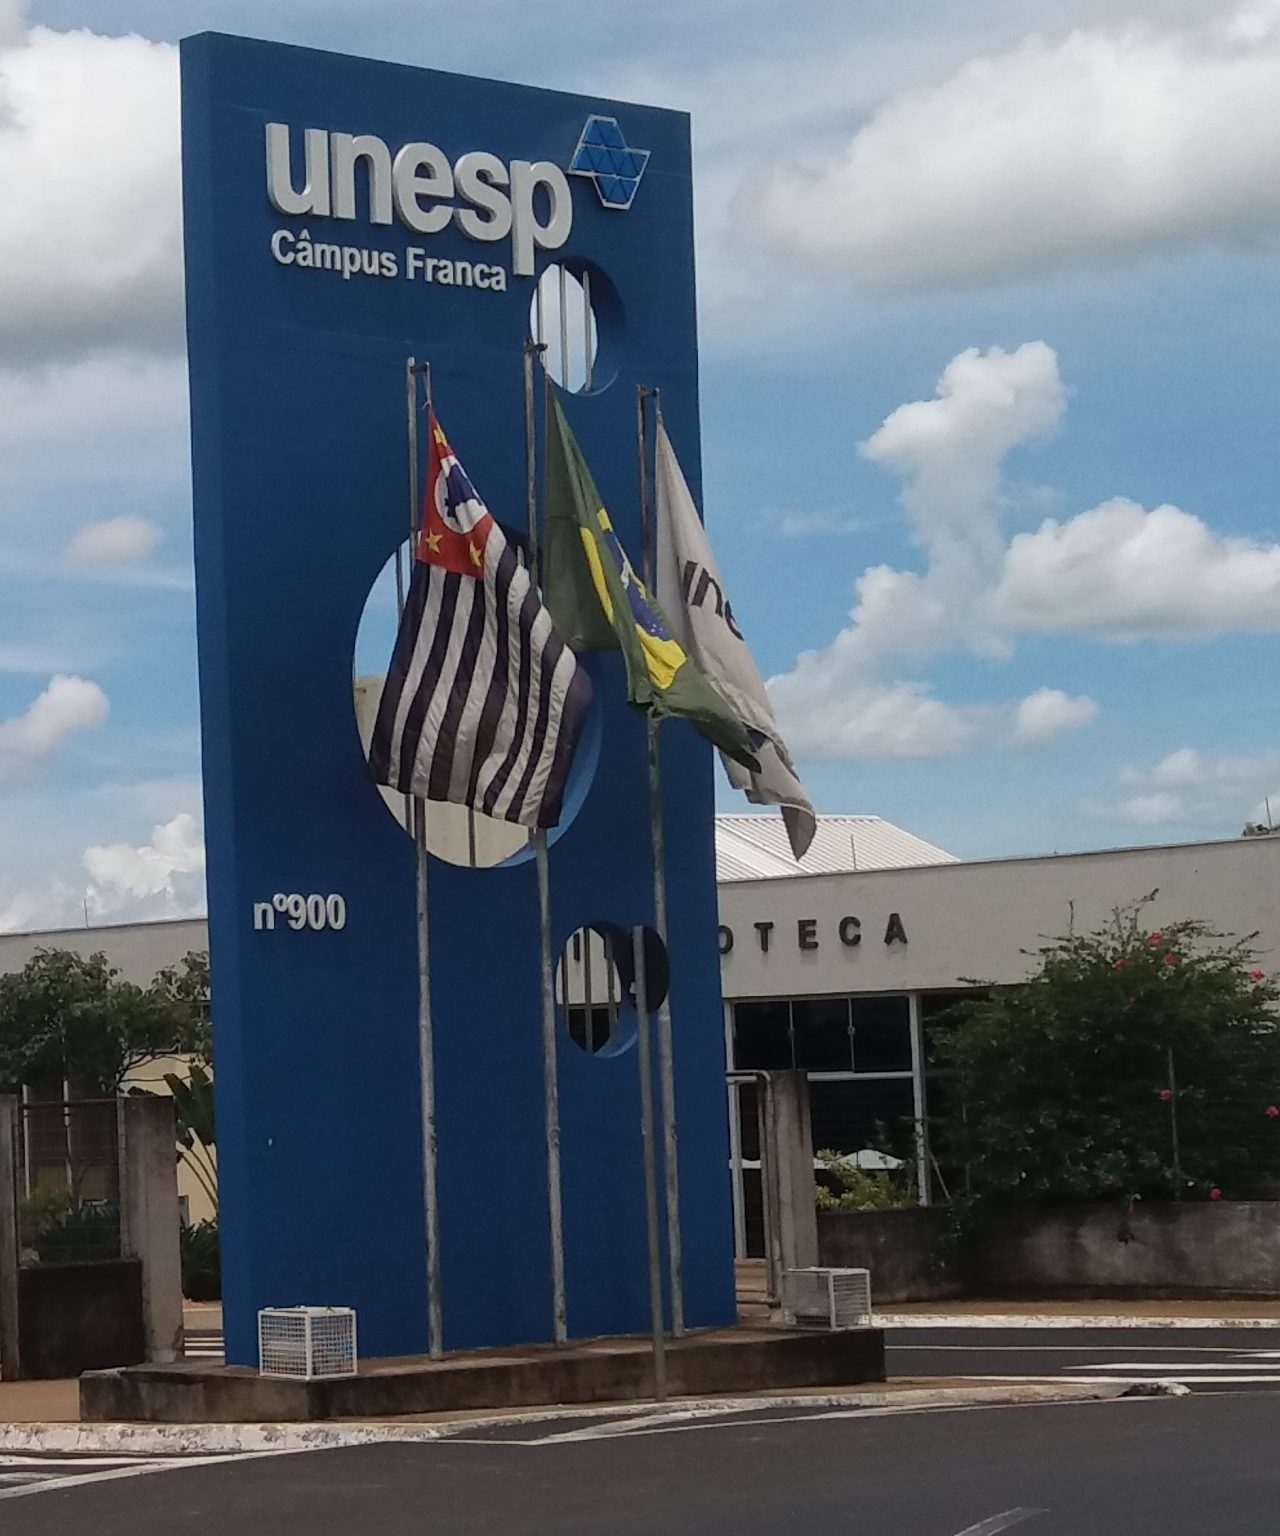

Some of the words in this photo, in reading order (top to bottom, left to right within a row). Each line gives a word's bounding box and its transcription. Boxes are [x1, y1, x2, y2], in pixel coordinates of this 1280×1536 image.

[265, 122, 573, 275] unesp
[271, 229, 398, 280] Câmpus
[406, 246, 507, 291] Franca
